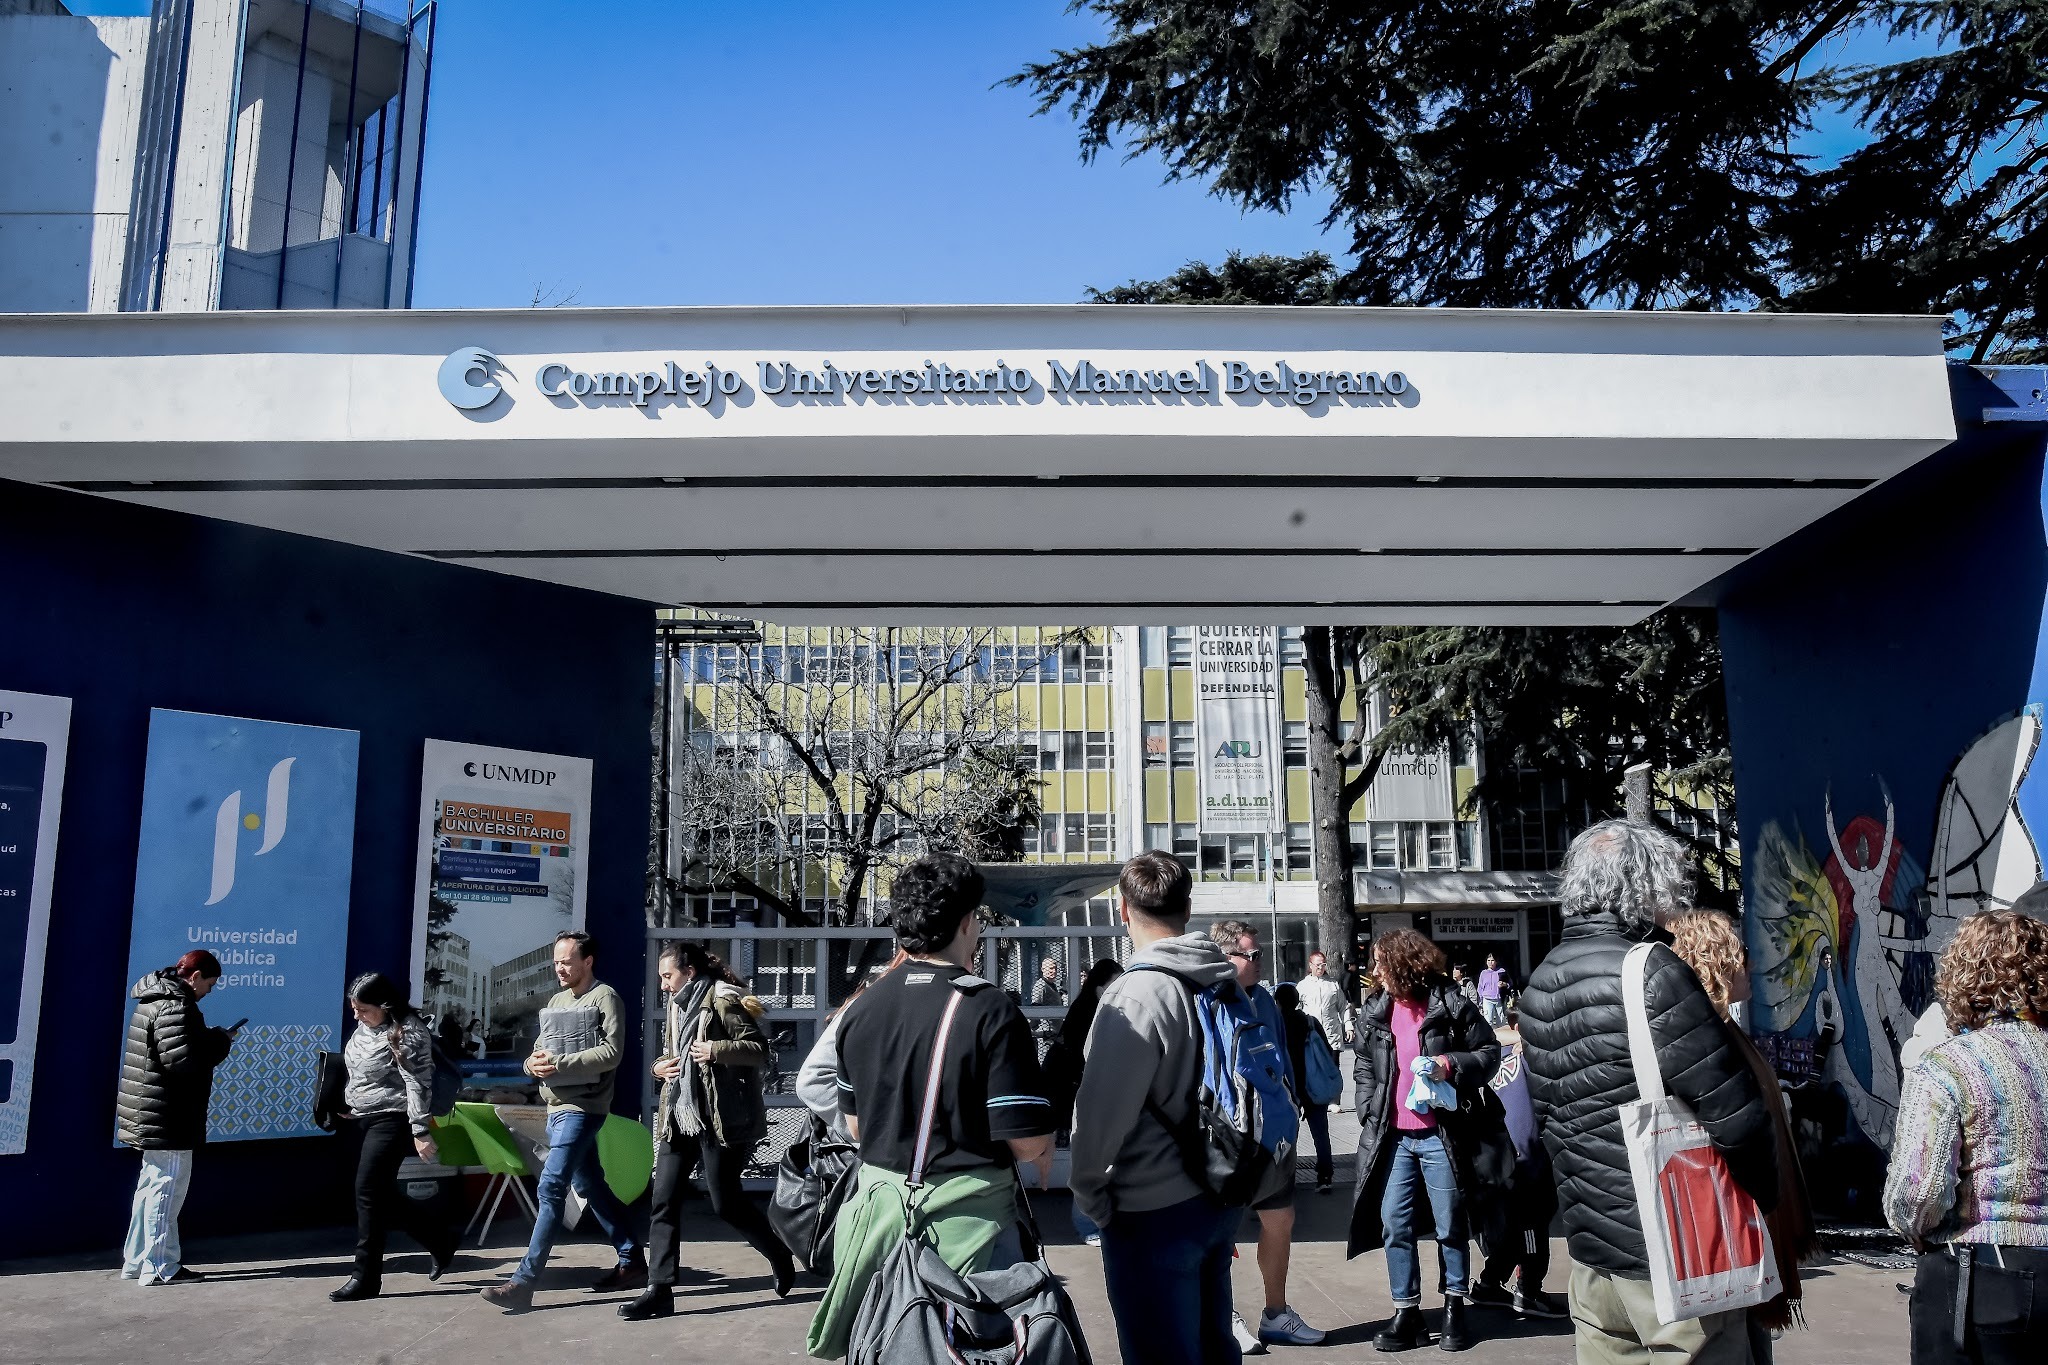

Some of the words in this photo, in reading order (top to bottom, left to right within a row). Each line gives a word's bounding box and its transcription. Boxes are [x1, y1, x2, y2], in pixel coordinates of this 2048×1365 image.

[535, 361, 742, 407] Complejo
[756, 359, 1033, 395] Universitario
[1047, 359, 1211, 394] Manuel
[1223, 360, 1409, 405] Belgrano
[1200, 626, 1272, 637] QUIEREN
[1200, 641, 1253, 656] CERRAR
[1257, 641, 1273, 656] LA
[1200, 661, 1274, 673] UNIVERSIDAD
[1200, 683, 1275, 693] DEFENDELA
[483, 763, 557, 786] UNMDP
[446, 805, 534, 824] BACHILLER
[445, 819, 566, 840] UNIVERSITARIO
[490, 867, 517, 875] UNMDP
[441, 882, 483, 892] APERTURA
[485, 884, 495, 892] DE
[496, 885, 506, 893] LA
[507, 886, 547, 895] SOLICITUD
[440, 892, 452, 900] del
[188, 926, 298, 945] Universidad
